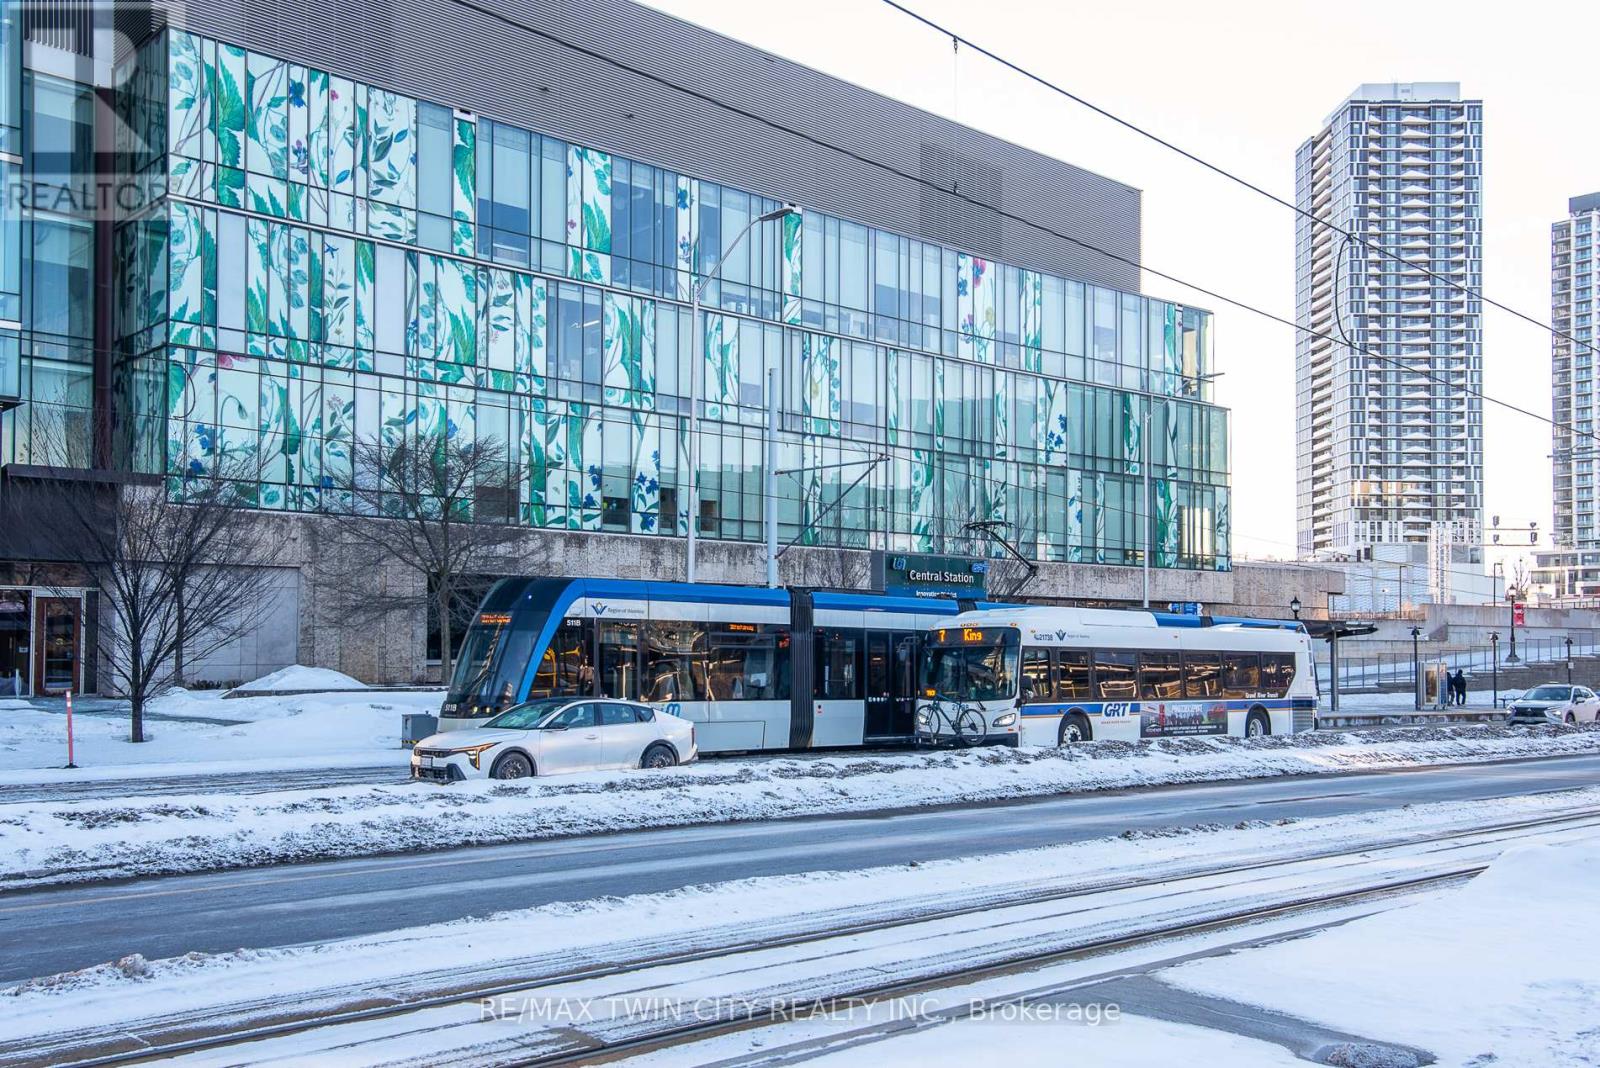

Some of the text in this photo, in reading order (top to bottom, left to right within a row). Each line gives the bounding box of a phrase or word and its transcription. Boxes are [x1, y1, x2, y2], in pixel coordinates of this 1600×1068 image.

[909, 569, 975, 583] Central Station
[938, 628, 983, 642] 7 King
[1104, 702, 1129, 717] GRT
